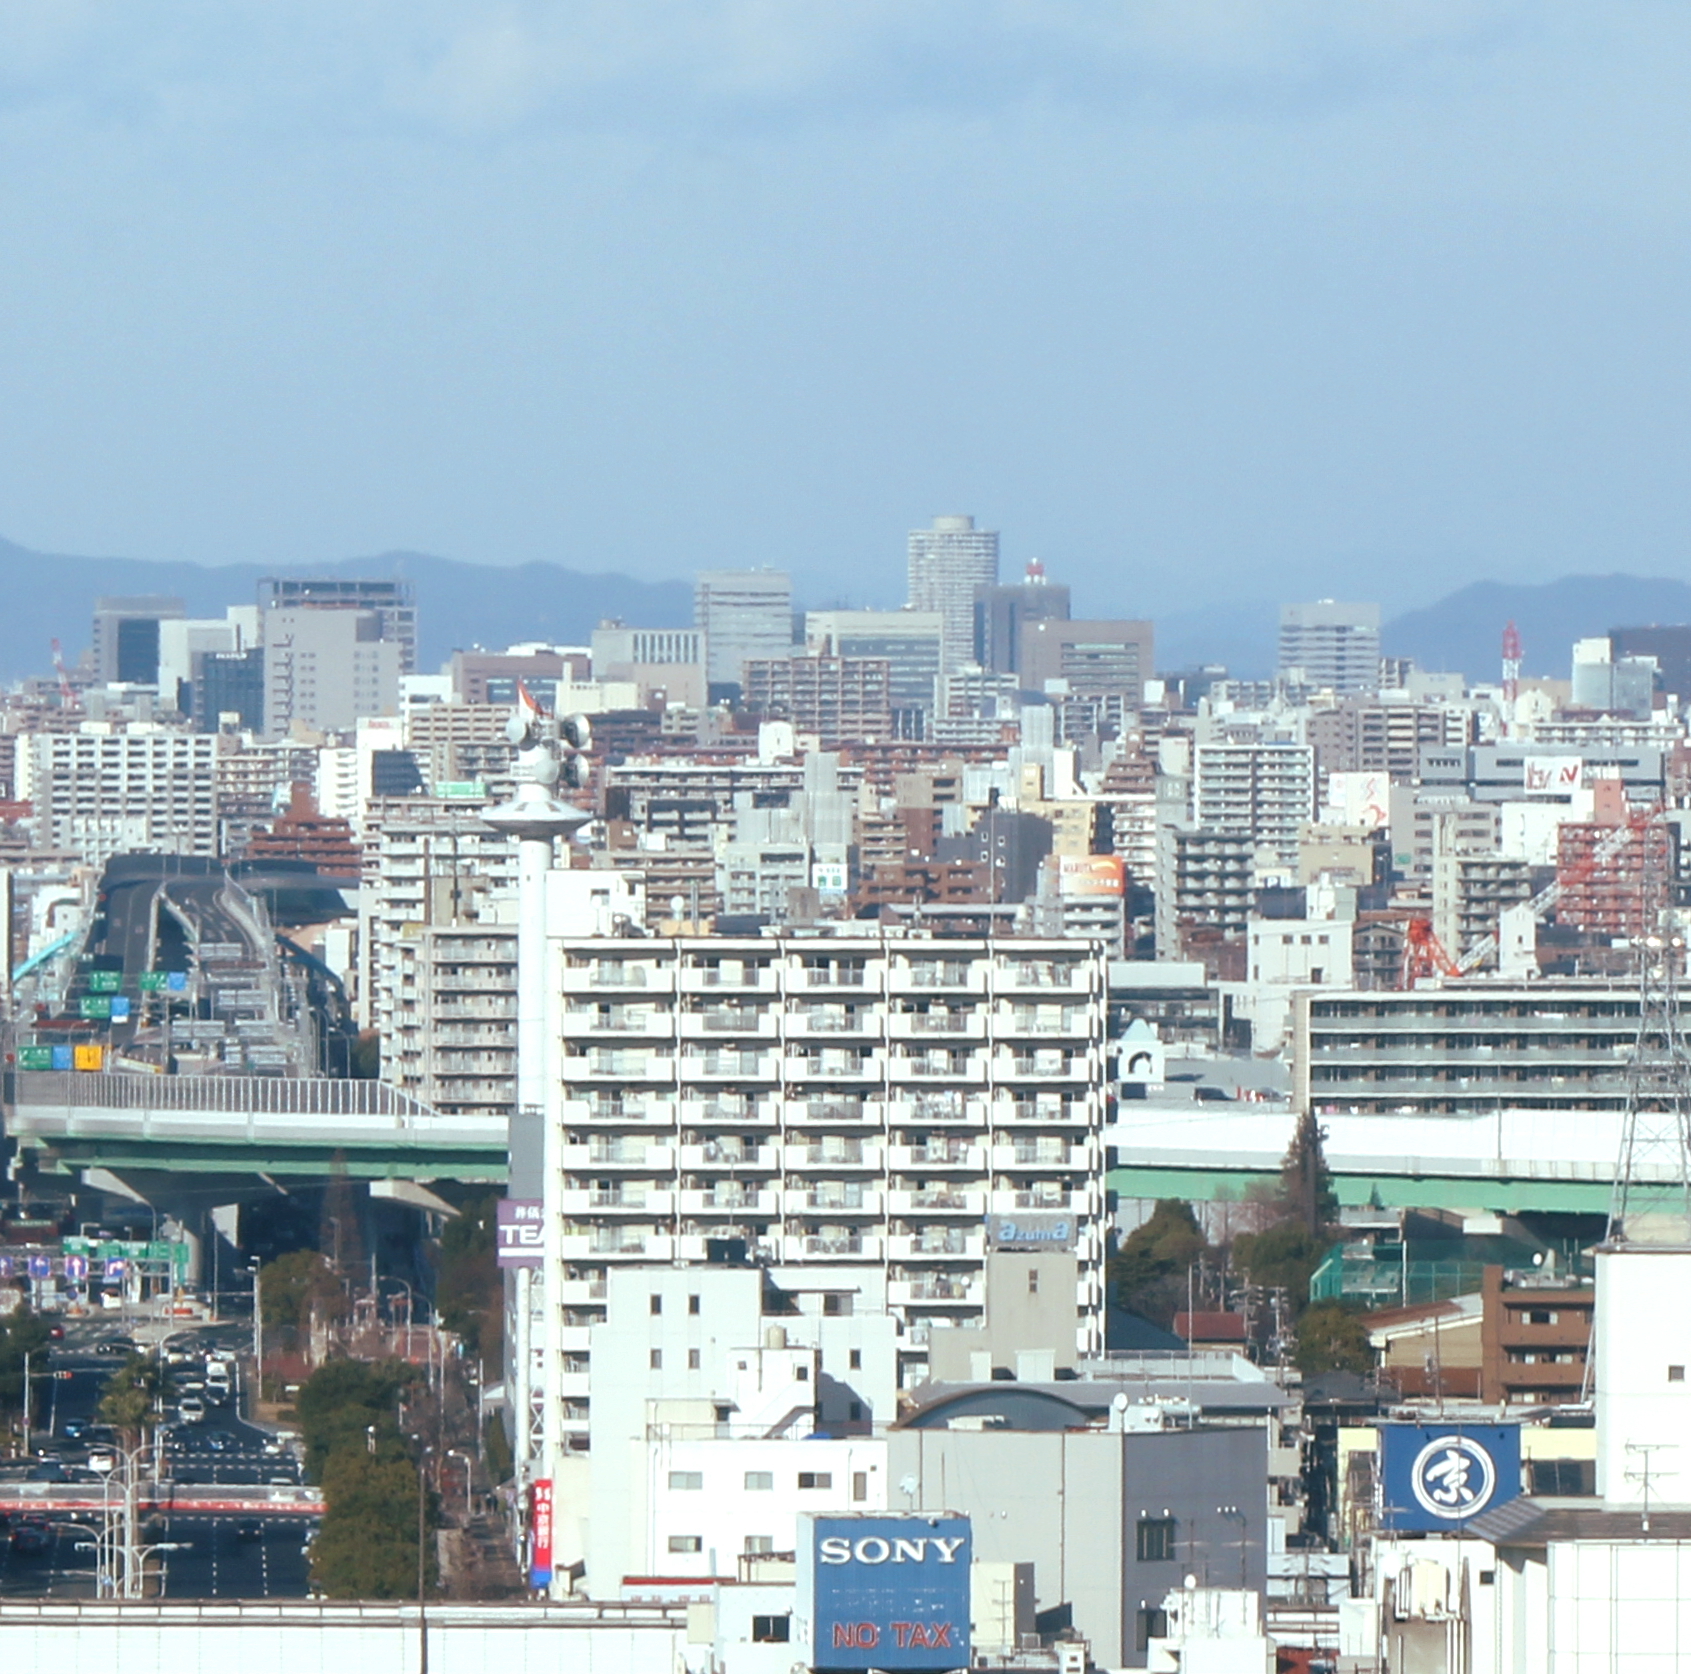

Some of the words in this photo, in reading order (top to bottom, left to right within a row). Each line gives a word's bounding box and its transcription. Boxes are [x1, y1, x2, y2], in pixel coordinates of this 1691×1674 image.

[999, 1219, 1070, 1242] azuma
[819, 1536, 966, 1565] SONY
[832, 1621, 880, 1649] NO
[890, 1621, 953, 1649] TAX
